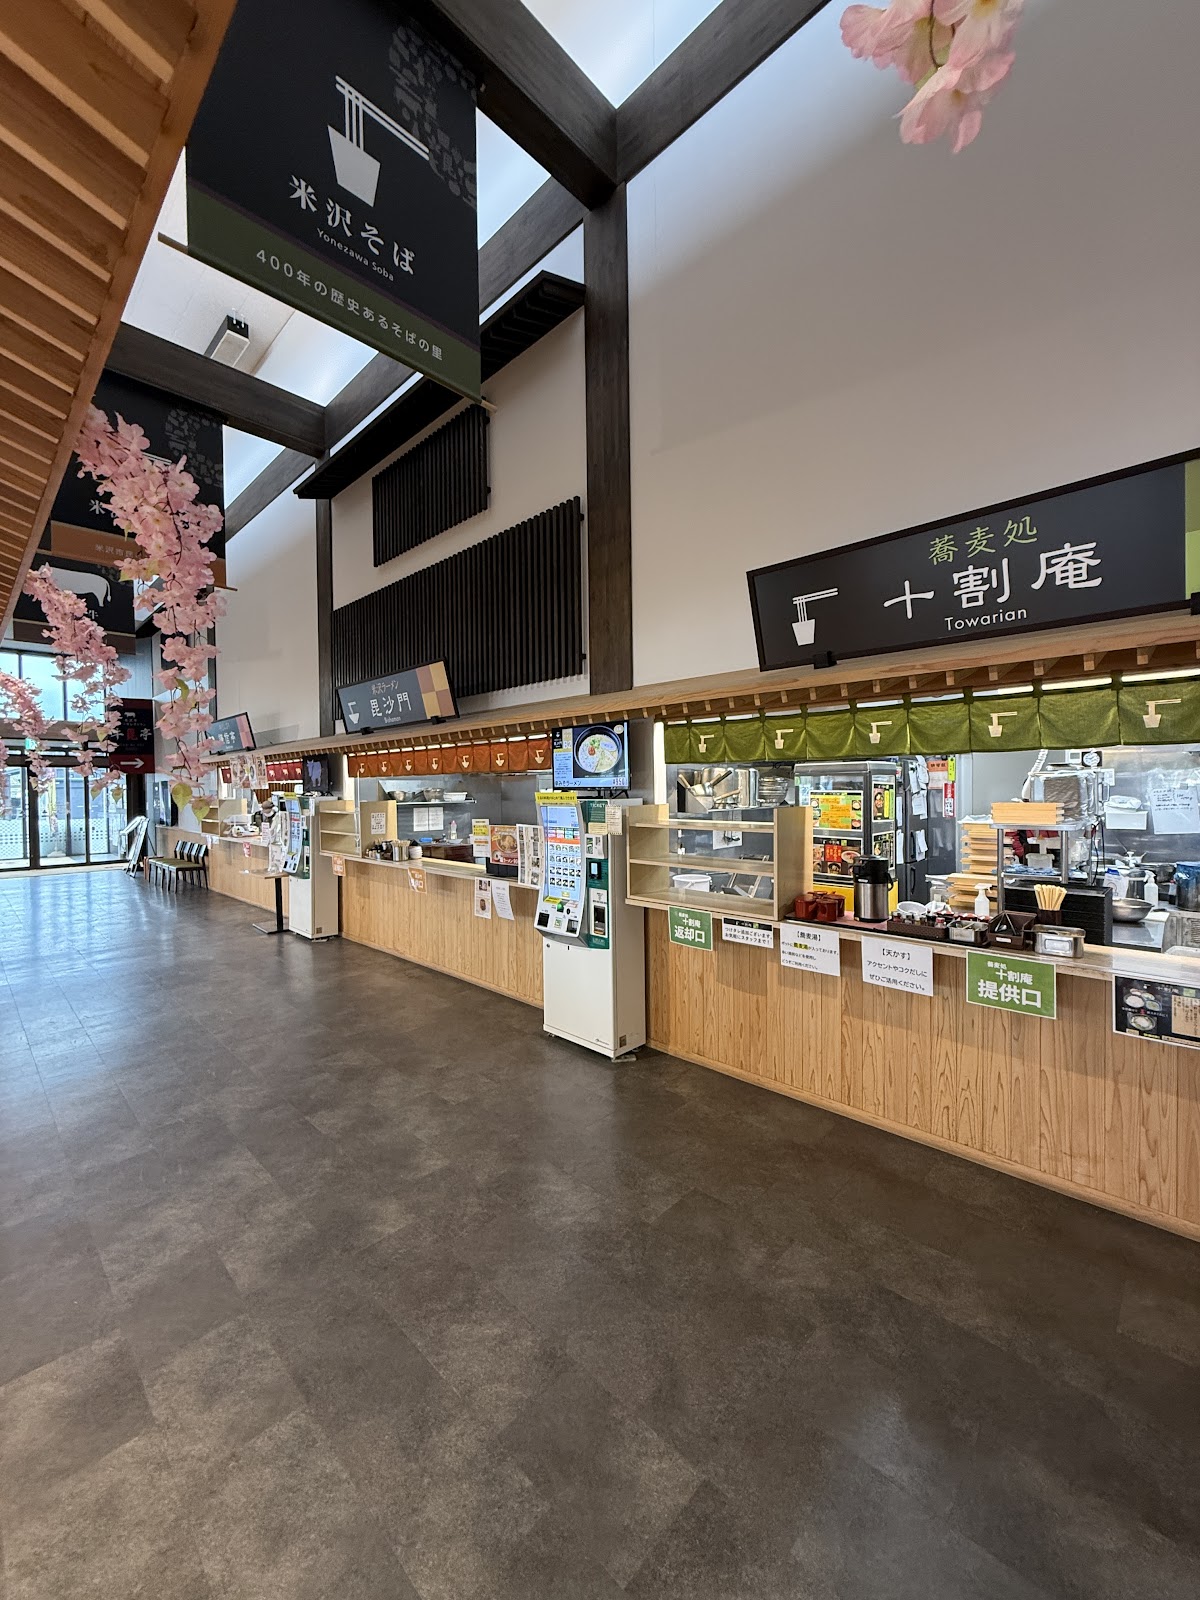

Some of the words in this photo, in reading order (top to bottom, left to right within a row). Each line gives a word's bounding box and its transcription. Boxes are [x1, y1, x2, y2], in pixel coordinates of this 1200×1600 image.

[288, 174, 416, 276] 米沢そば
[316, 228, 369, 267] Yonezawa
[372, 256, 395, 282] Soba
[256, 248, 443, 362] 400年の歴史あるそばの里
[928, 515, 1038, 566] 蕎麦処
[883, 540, 1103, 620] 十割庵
[944, 607, 1028, 632] Towarian
[369, 691, 412, 718] 毘沙門
[674, 924, 706, 944] 返却口
[866, 960, 928, 978] アクセントやコクだしに
[869, 973, 926, 991] ぜひご活用ください。
[995, 968, 1034, 986] 十割庵
[977, 978, 1042, 1009] 提供口
